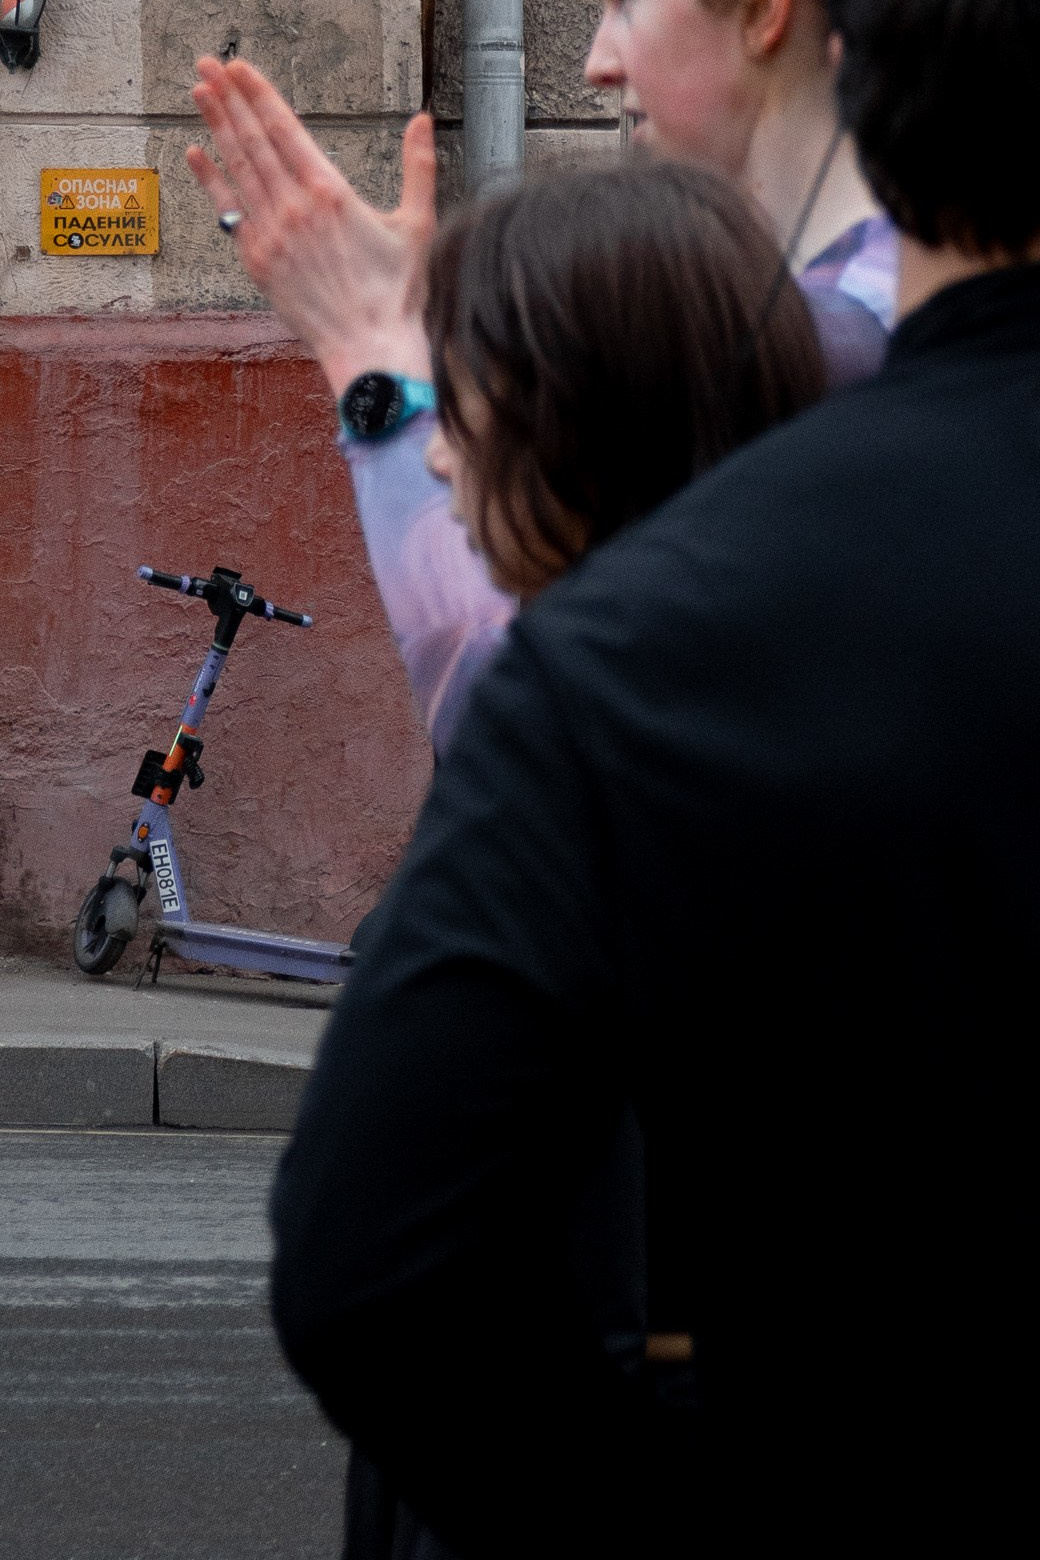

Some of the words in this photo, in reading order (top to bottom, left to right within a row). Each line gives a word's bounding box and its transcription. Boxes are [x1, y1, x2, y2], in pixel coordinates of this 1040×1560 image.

[58, 179, 138, 194] ОПАСНАЯ
[76, 194, 122, 210] ЗОНА
[54, 216, 147, 232] ПАДЕНИЕ
[53, 233, 147, 249] ССУЛЕК
[151, 843, 179, 909] EH081E
